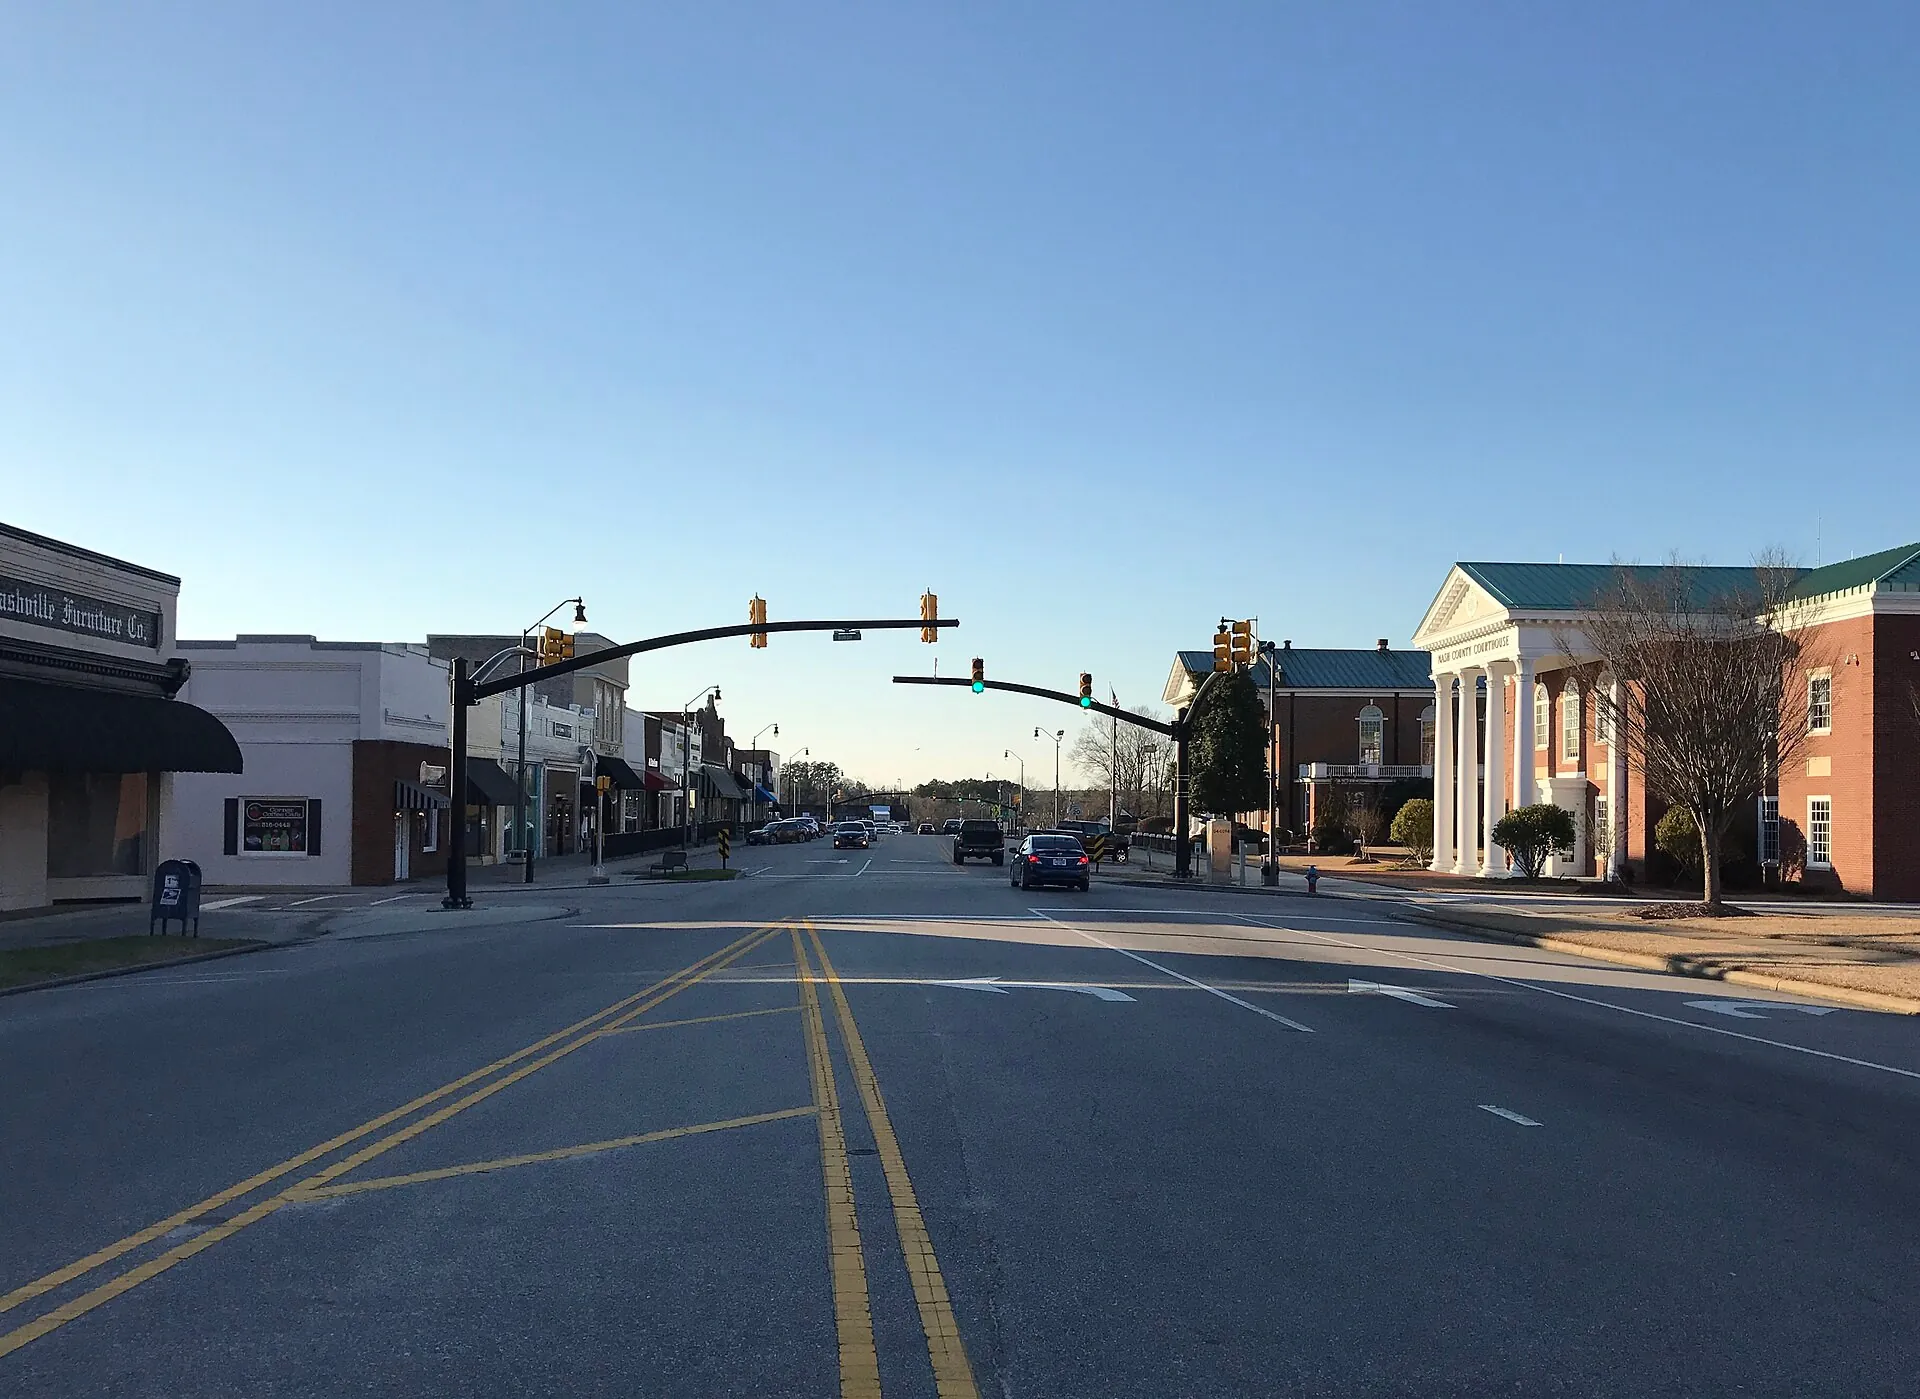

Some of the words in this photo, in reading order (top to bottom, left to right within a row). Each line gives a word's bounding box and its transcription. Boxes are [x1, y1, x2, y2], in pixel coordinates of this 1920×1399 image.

[62, 596, 123, 635] Furniture
[127, 614, 147, 641] Co.
[1437, 652, 1451, 664] NASH
[1452, 646, 1472, 661] COUNTY
[1473, 635, 1510, 654] COURTHOUSE
